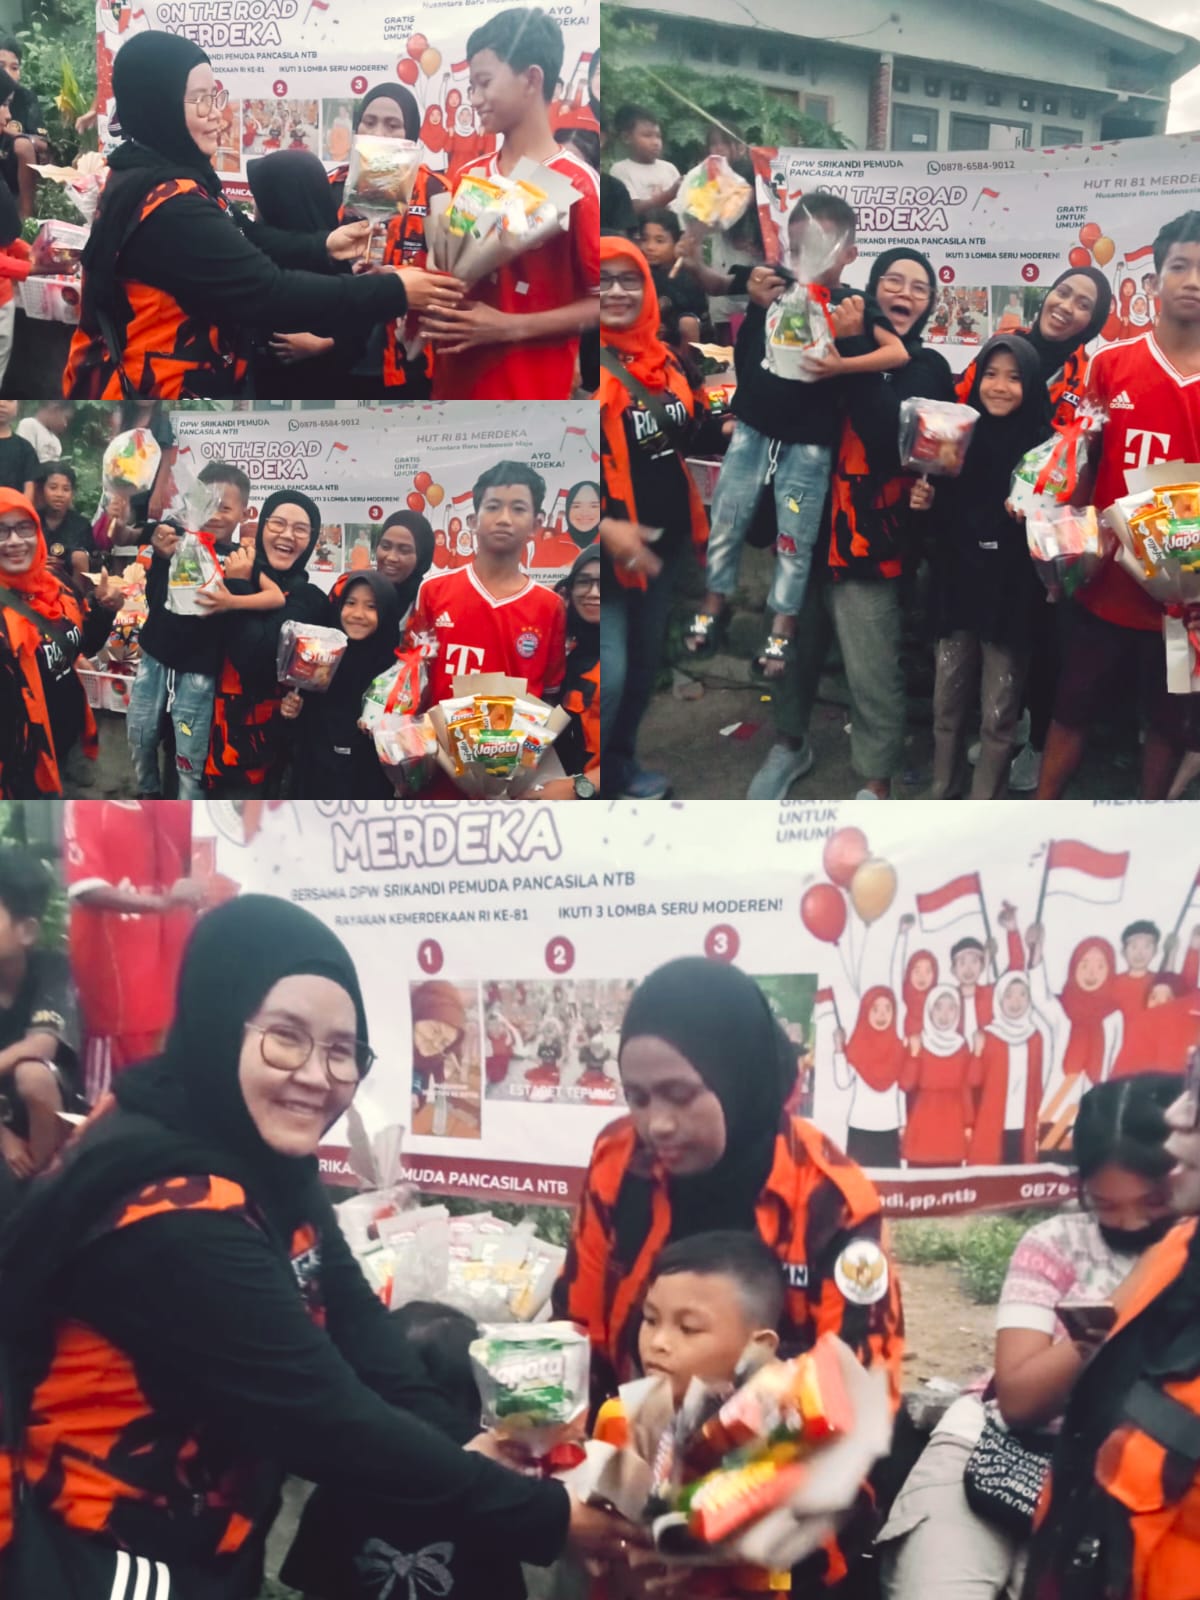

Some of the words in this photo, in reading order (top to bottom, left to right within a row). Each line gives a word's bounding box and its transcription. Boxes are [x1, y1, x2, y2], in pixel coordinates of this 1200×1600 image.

[157, 3, 185, 23] ON
[190, 1, 232, 22] THE
[235, 0, 298, 20] ROAD
[549, 6, 573, 15] AYO
[384, 16, 415, 24] GRATIS
[556, 16, 590, 26] DEKA!
[384, 24, 413, 32] UNTUK
[208, 53, 224, 61] ANDI
[225, 53, 255, 61] PEMUDA
[257, 52, 299, 60] PANCASILA
[301, 51, 318, 59] NTB
[349, 64, 389, 72] MODEREN!
[791, 160, 816, 168] DPW
[817, 160, 861, 169] SRIKANDI
[863, 160, 904, 169] PEMUDA
[941, 161, 1015, 172] 0878-6584-9012
[789, 169, 842, 178] PANCASILA
[844, 170, 865, 178] NTB
[1083, 179, 1112, 190] HUT
[1114, 178, 1127, 188] RI
[1130, 177, 1145, 188] 81
[225, 187, 254, 197] PANCA
[850, 185, 899, 206] THE
[900, 185, 968, 206] ROAD
[1095, 191, 1137, 199] Nusantara
[1056, 205, 1088, 214] GRATIS
[855, 206, 949, 232] RDEKA
[1056, 213, 1086, 221] UNTUK
[857, 237, 886, 245] RIKANDI
[888, 237, 920, 245] PEMUDA
[921, 237, 967, 245] PANCASILA
[969, 237, 987, 245] NTB
[1020, 252, 1060, 260] MODEREN!
[201, 420, 235, 428] SRIKANDI
[237, 418, 270, 427] PEMUDA
[179, 428, 221, 436] PANCASILA
[416, 434, 439, 443] HUT
[441, 433, 452, 442] RI
[471, 429, 528, 441] MERDEKA
[201, 441, 226, 459] ON
[228, 441, 266, 459] THE
[267, 440, 322, 459] ROAD
[531, 452, 551, 460] AYO
[530, 460, 566, 469] RDEKA!
[1168, 532, 1200, 550] Japo
[478, 742, 518, 758] Japota
[779, 807, 838, 825] UNTUK
[331, 808, 563, 873] MERDEKA
[290, 887, 347, 901] BERSAMA
[349, 885, 380, 899] DPW
[383, 881, 446, 898] SRIKANDI
[449, 878, 509, 895] PEMUDA
[513, 873, 599, 891] PANCASILA
[603, 871, 636, 887] NTB
[558, 905, 593, 920] IKUTI
[596, 904, 604, 918] 3
[607, 903, 657, 918] LOMBA
[660, 901, 698, 917] SERU
[703, 898, 783, 915] MODEREN!
[335, 914, 387, 926] RAYAKAN
[389, 910, 475, 925] KEMERDEKAAN
[478, 909, 490, 922] RI
[493, 908, 529, 921] KE-81
[713, 932, 728, 954] 3
[423, 946, 433, 966] 1
[553, 945, 566, 966] 2
[318, 1158, 353, 1175] RIKA
[400, 1168, 446, 1185] MUDA
[449, 1171, 534, 1192] PANCASILA
[537, 1178, 569, 1195] NTB
[880, 1187, 977, 1211] di.pp.ntb
[980, 1476, 1038, 1502] COLORBOX
